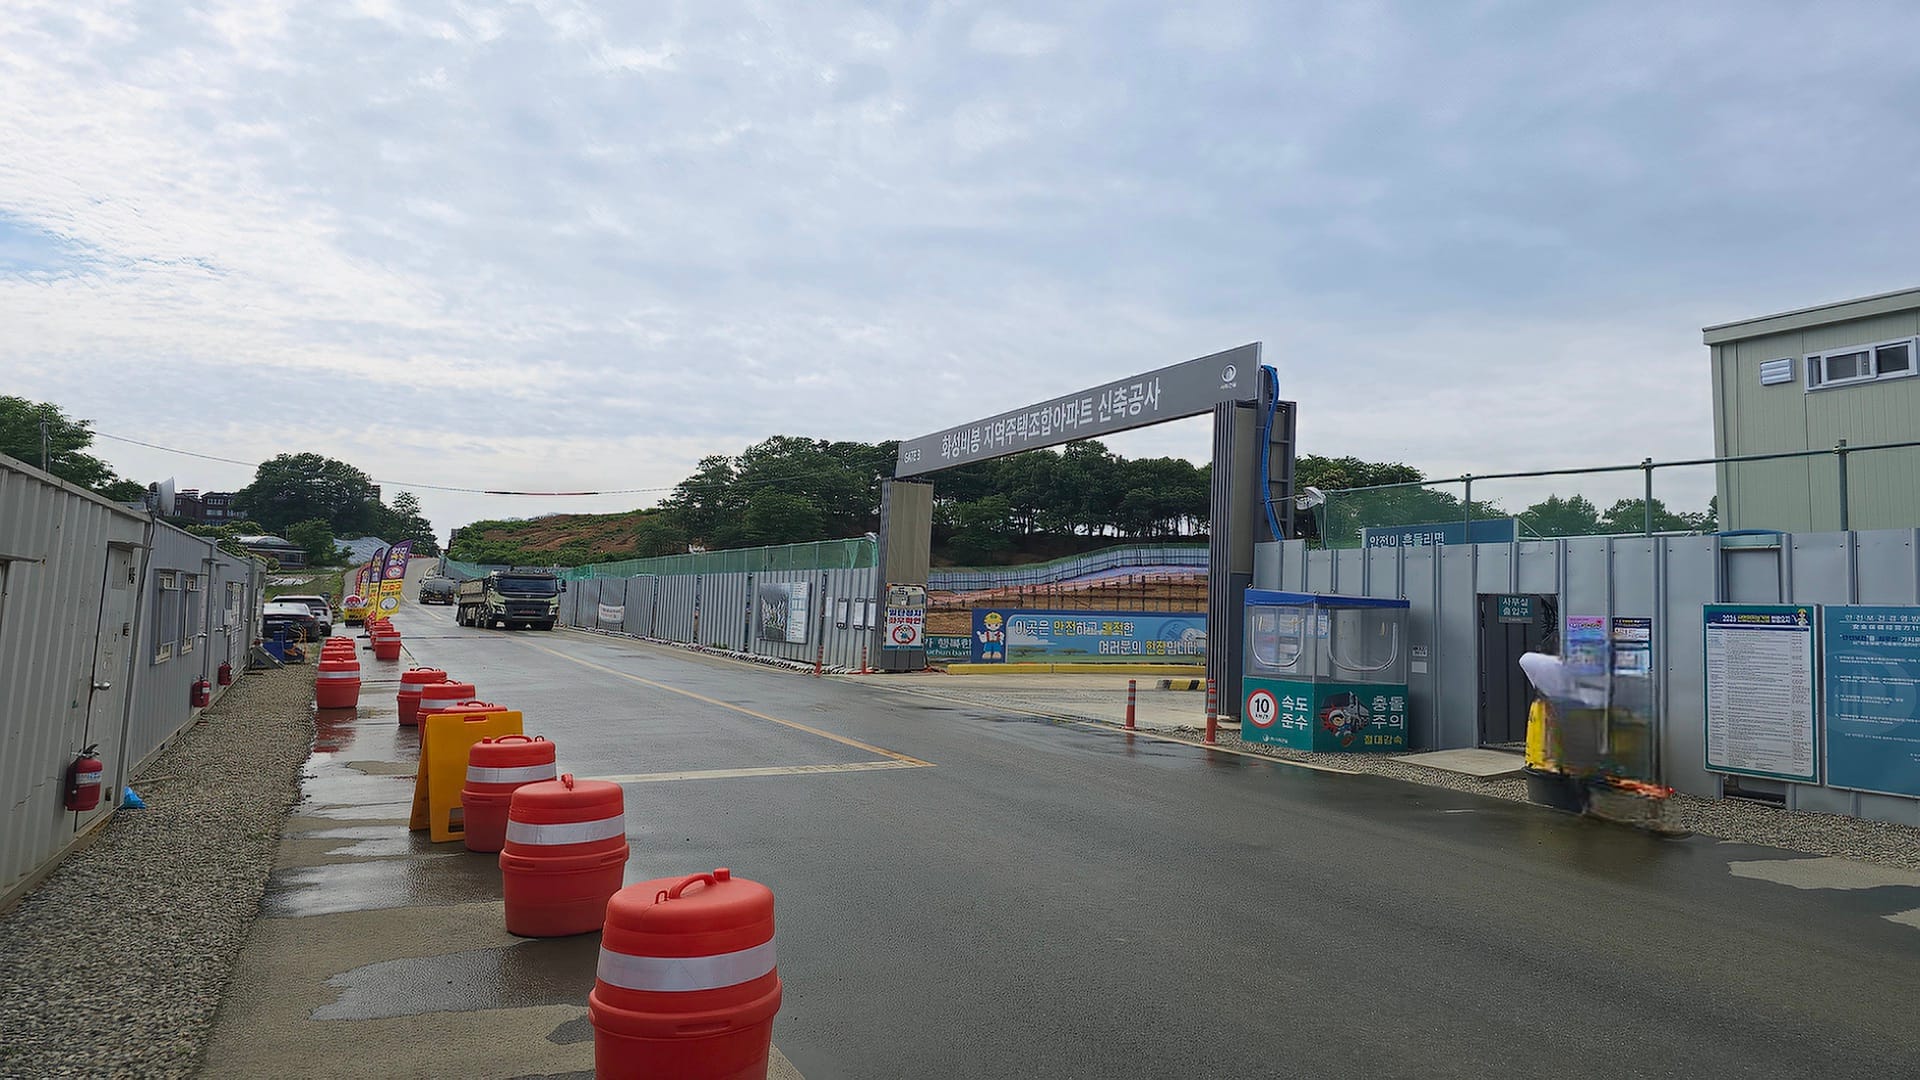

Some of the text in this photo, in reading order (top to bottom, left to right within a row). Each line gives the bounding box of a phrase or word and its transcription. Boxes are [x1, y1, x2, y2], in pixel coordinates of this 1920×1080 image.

[941, 377, 1161, 459] 화성비봉 지역주택조합아파트 신축공사
[1502, 597, 1528, 606] 사무실
[1502, 607, 1528, 616] 출입구
[1015, 619, 1049, 636] 이곳은
[1053, 620, 1097, 636] 안전하고
[1098, 640, 1142, 655] 여러분의
[1255, 698, 1269, 713] 10
[1282, 695, 1308, 712] 속도
[1372, 695, 1404, 712] 충돌
[1281, 713, 1308, 730] 준수
[1372, 714, 1403, 729] 주의
